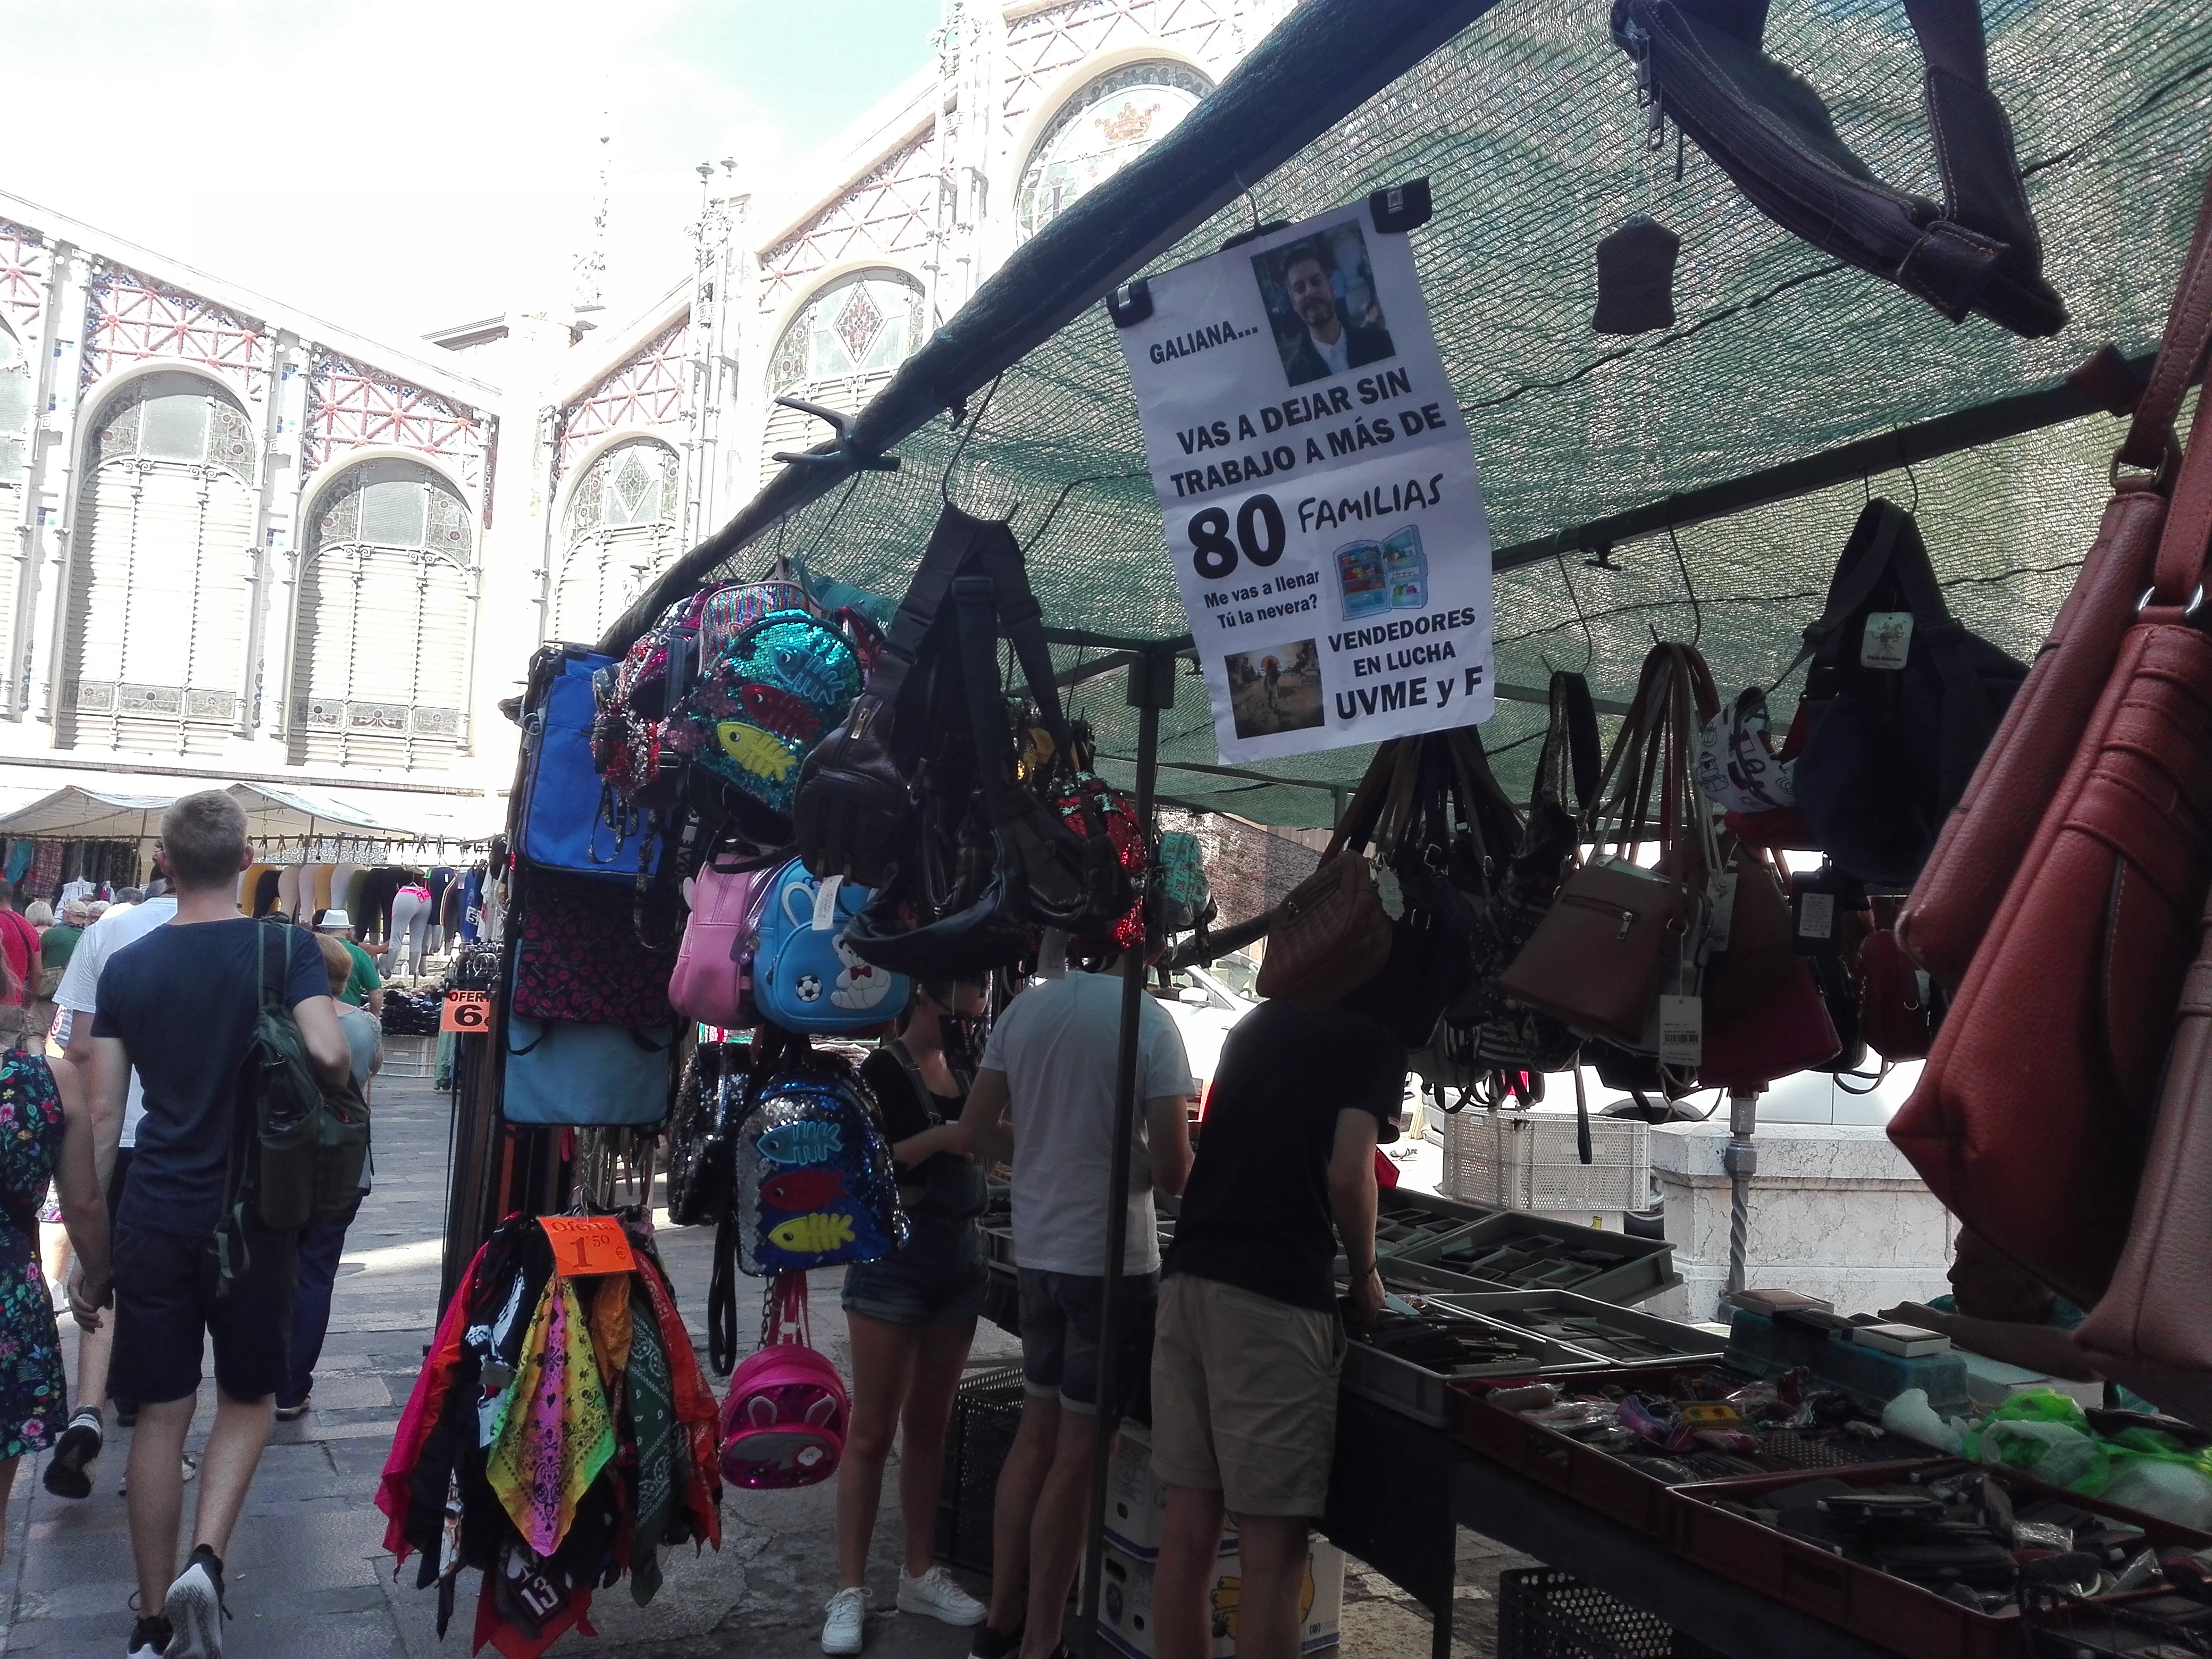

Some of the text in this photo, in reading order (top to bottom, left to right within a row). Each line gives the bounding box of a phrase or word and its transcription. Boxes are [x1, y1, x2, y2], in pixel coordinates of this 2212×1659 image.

[1150, 321, 1259, 364] GALIANA...
[1176, 367, 1412, 455] VAS A DEJAR SIN
[1170, 403, 1447, 498] TRABAJO A MÁS DE
[1188, 473, 1444, 580] 80 FAMILIAS
[1204, 571, 1319, 608] Me vas a llenar
[1217, 593, 1318, 629] Tú la nevera?
[1328, 607, 1476, 652] VENDEDORES
[1354, 641, 1456, 677] EN LUCHA
[1336, 665, 1484, 719] UVME y F
[468, 912, 477, 924] 5
[450, 992, 489, 1002] OFER
[454, 1004, 482, 1027] 6
[551, 1221, 615, 1231] Oferta
